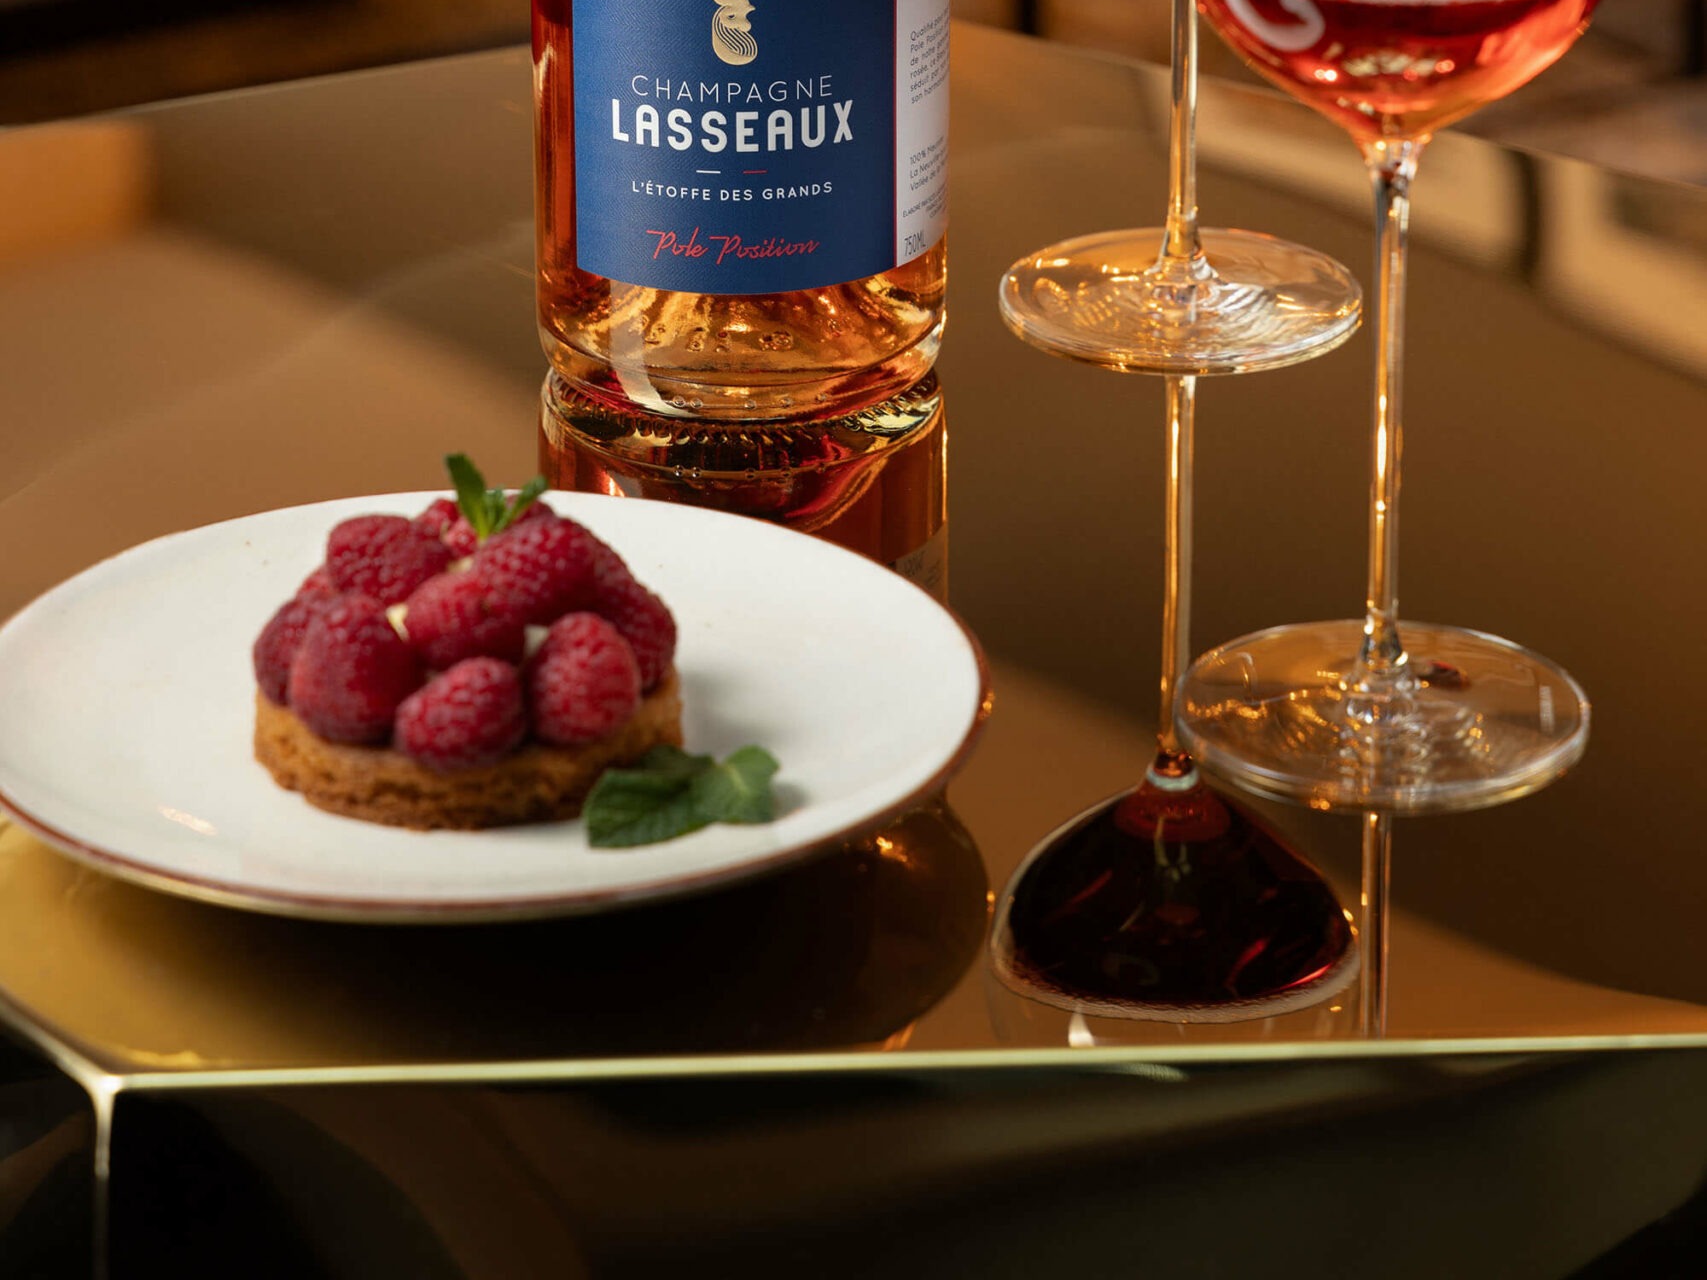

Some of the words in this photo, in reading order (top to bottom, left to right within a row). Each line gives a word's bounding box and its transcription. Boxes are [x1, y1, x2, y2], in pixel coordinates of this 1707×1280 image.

[631, 74, 833, 104] CHAMPAGNE
[611, 98, 853, 153] LASSEAUX
[632, 179, 711, 201] L'ÉTOFFE
[720, 189, 753, 201] DES
[762, 181, 833, 200] GRANDS
[646, 226, 709, 260] Pole
[709, 234, 820, 265] Position
